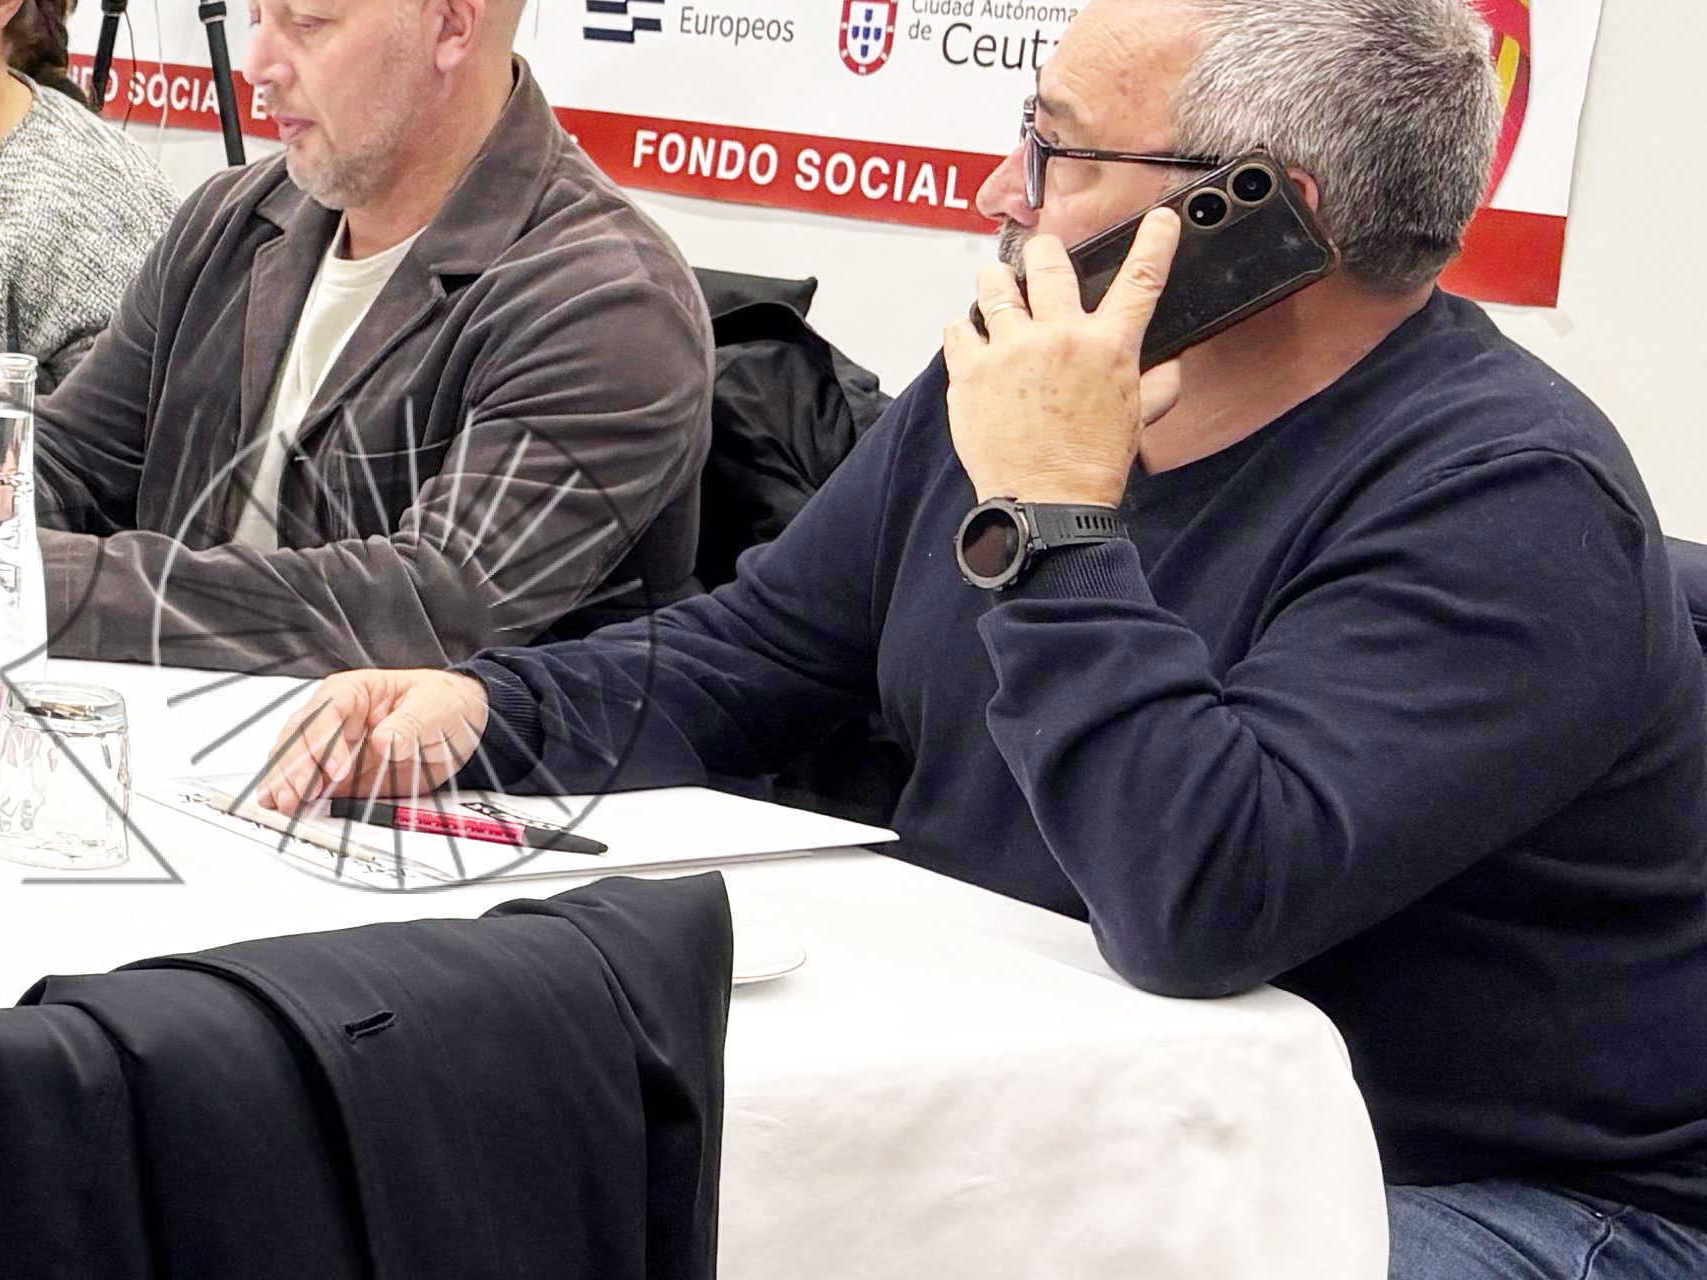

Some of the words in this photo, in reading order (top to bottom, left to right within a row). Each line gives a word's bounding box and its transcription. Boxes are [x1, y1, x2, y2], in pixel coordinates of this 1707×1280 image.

[680, 5, 795, 47] Europeos
[908, 19, 933, 41] de
[942, 22, 1060, 71] Ceut
[127, 71, 221, 115] SOCIA
[632, 129, 778, 186] FONDO
[794, 148, 969, 210] SOCIAL
